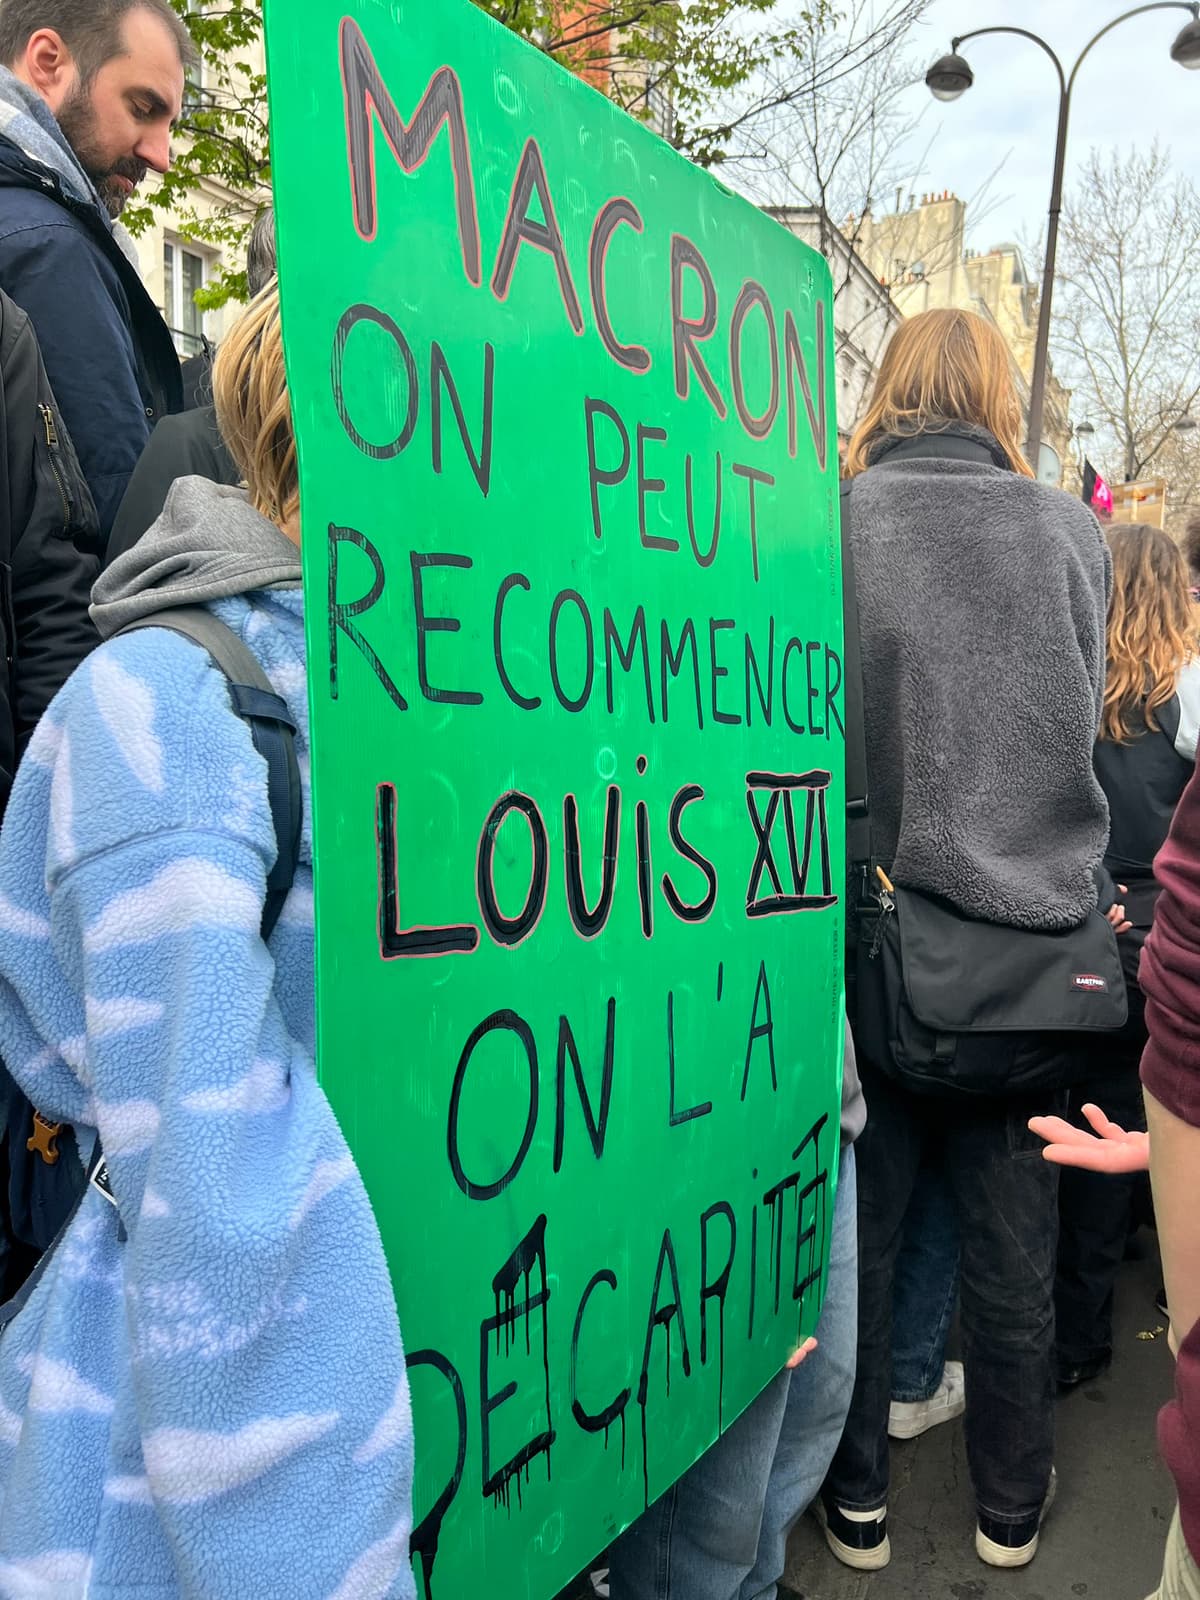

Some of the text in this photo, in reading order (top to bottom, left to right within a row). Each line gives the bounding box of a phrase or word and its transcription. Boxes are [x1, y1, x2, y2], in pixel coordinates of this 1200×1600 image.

[339, 15, 826, 472] MACRON
[331, 303, 494, 498] ON
[585, 395, 775, 583] PEUT
[328, 522, 845, 741] RECOMMENCER
[746, 769, 839, 917] XVI
[447, 996, 616, 1200] ON
[668, 960, 777, 1127] L'A
